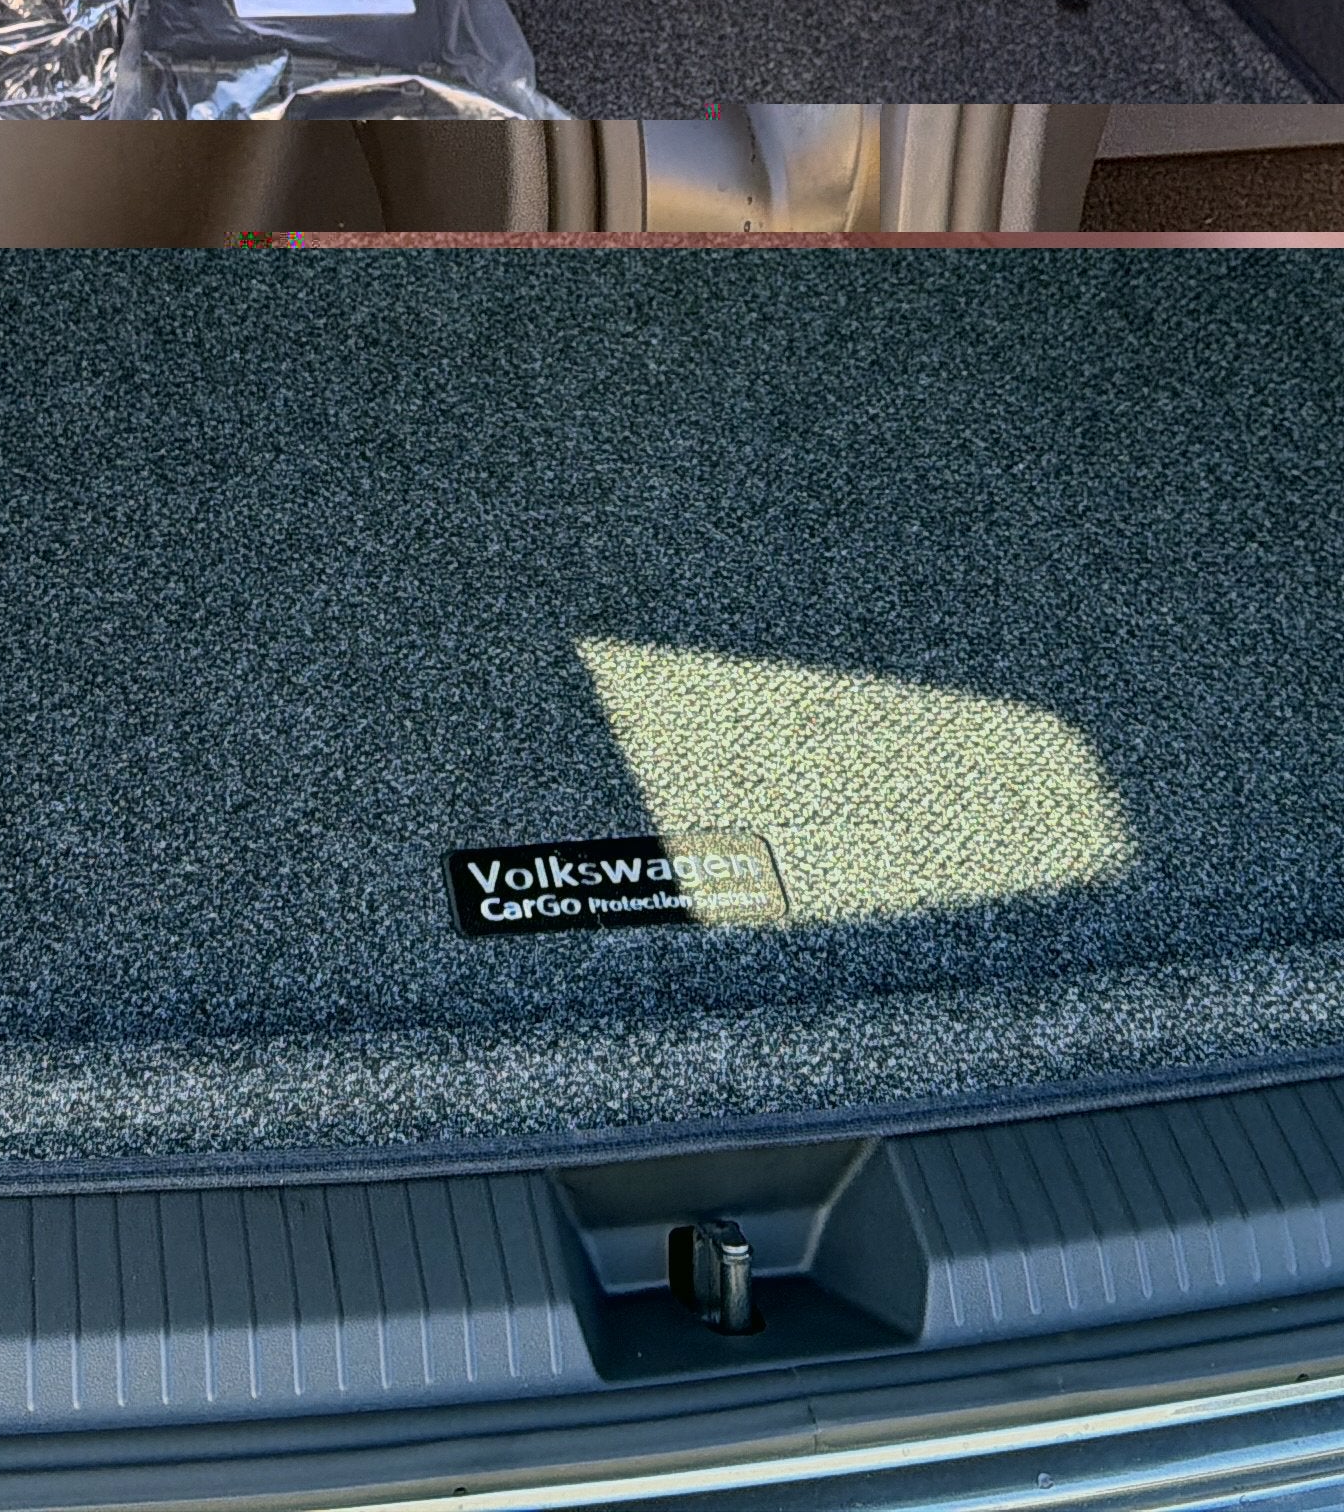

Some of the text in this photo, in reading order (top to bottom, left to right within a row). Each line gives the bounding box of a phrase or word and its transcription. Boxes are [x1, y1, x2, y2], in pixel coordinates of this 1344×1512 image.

[466, 853, 760, 895] Volkswagen
[480, 893, 582, 922] CarGo
[588, 890, 693, 914] Protection
